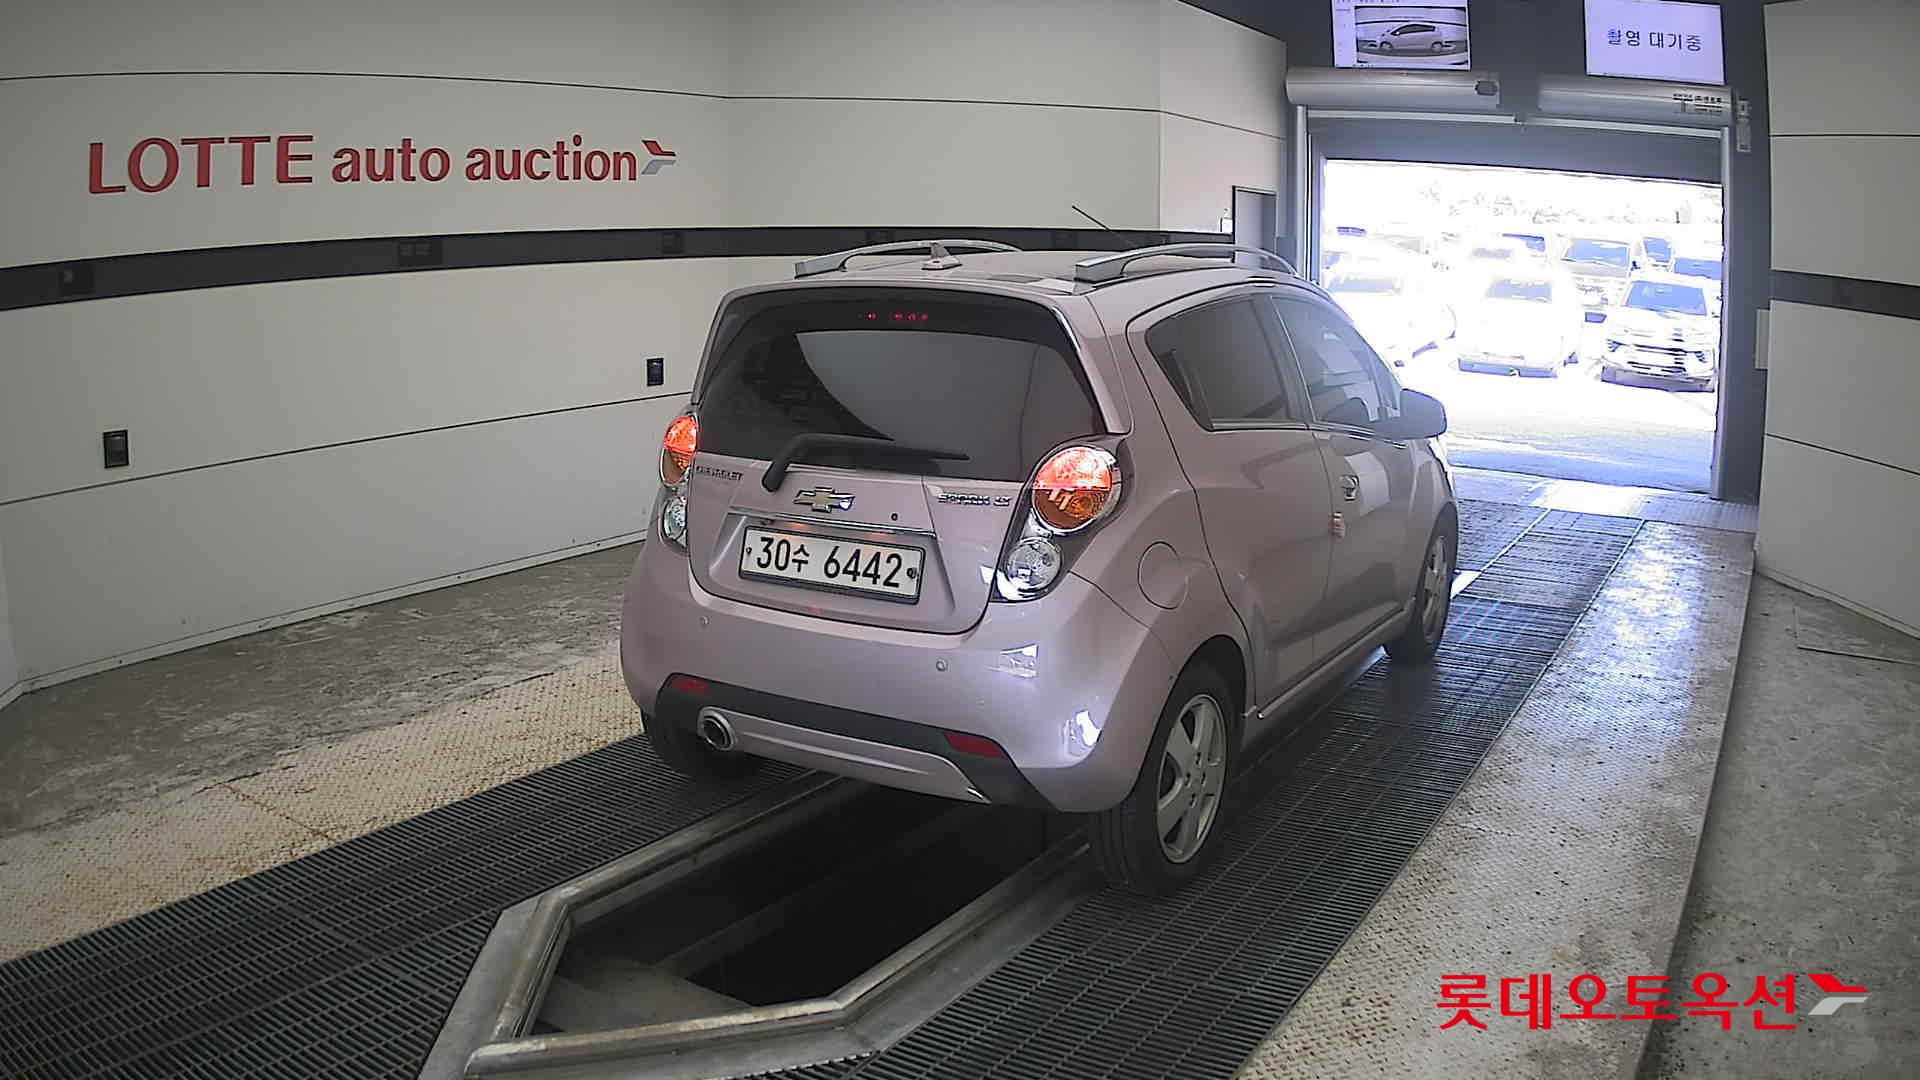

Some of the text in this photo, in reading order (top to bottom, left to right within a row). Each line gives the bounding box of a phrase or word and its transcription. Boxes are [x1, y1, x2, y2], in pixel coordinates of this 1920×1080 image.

[1649, 31, 1702, 52] 대기중
[88, 134, 639, 194] LOTTE auto auction
[756, 536, 902, 588] 30수 6442
